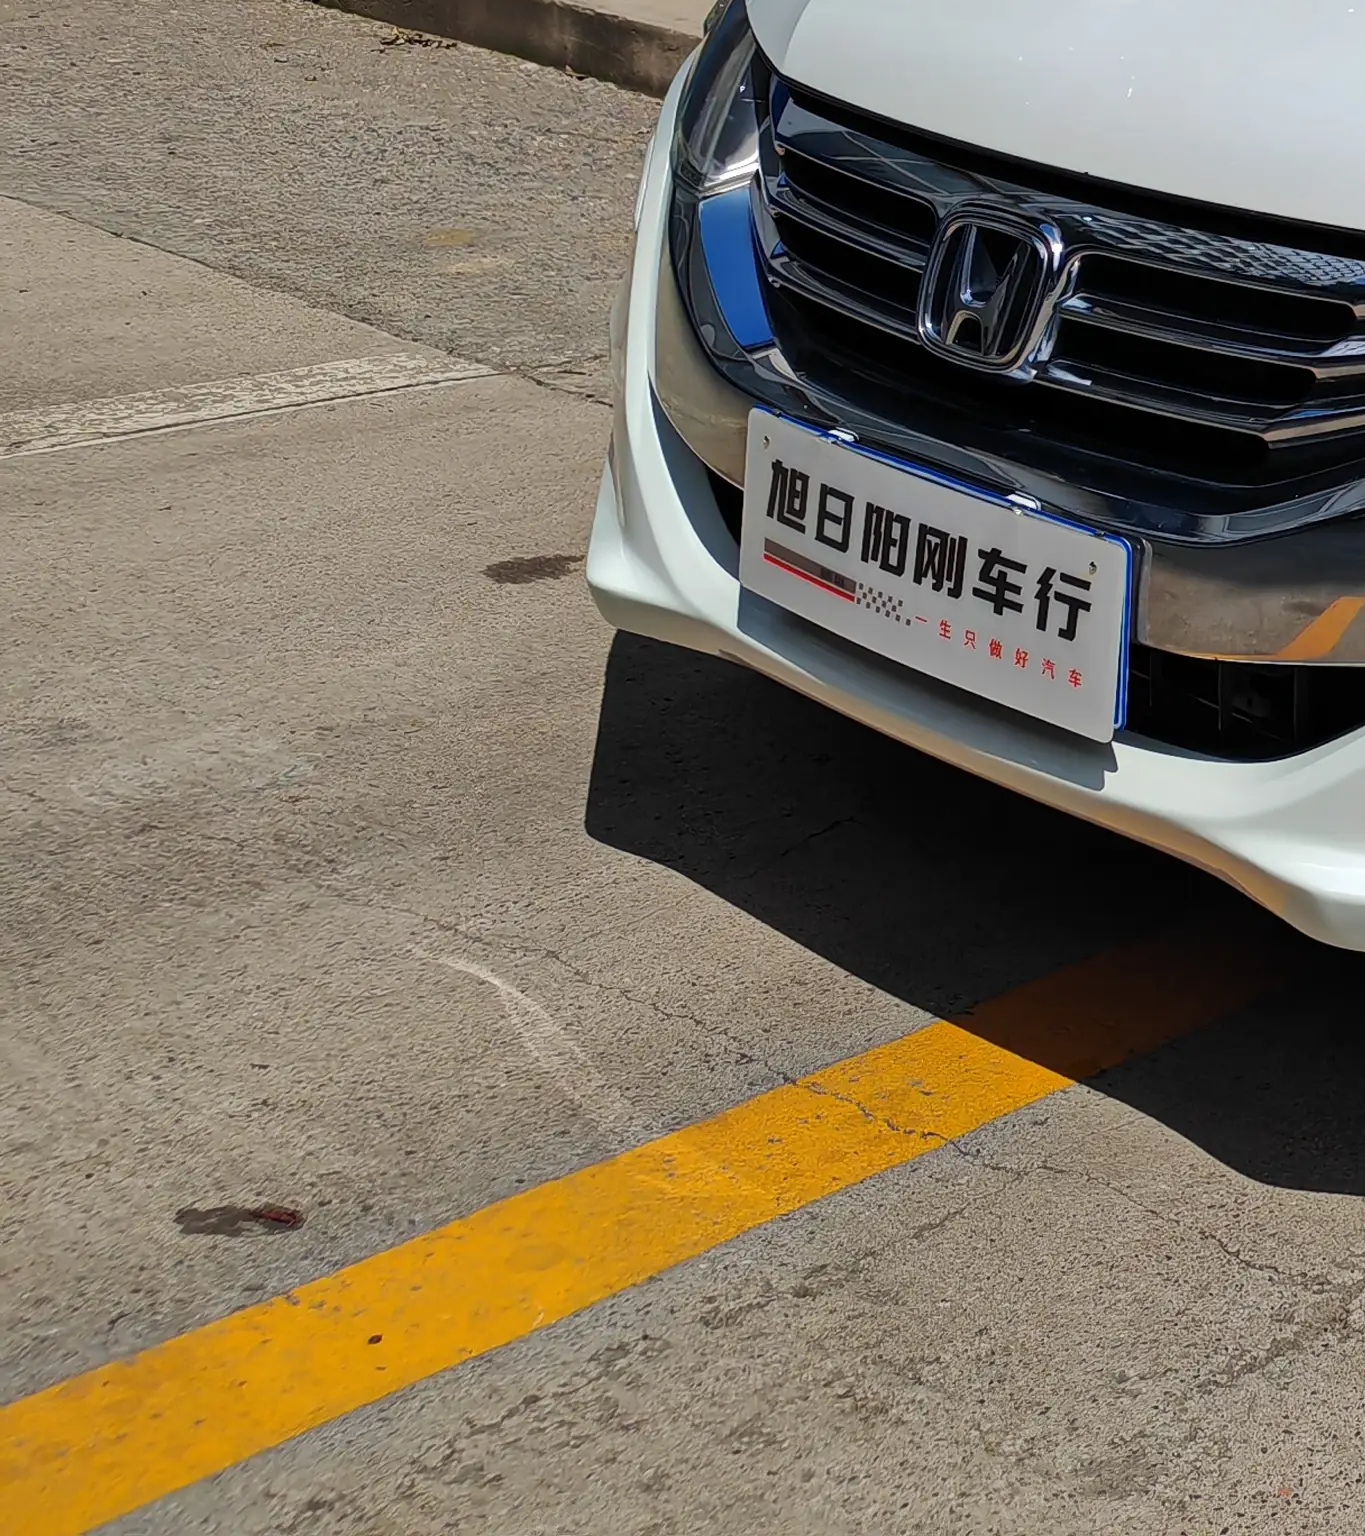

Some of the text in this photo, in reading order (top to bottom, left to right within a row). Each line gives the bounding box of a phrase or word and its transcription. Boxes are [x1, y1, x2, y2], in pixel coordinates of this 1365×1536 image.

[766, 458, 1092, 642] 旭日阳刚车行
[915, 615, 1083, 689] 一生只做好汽车
